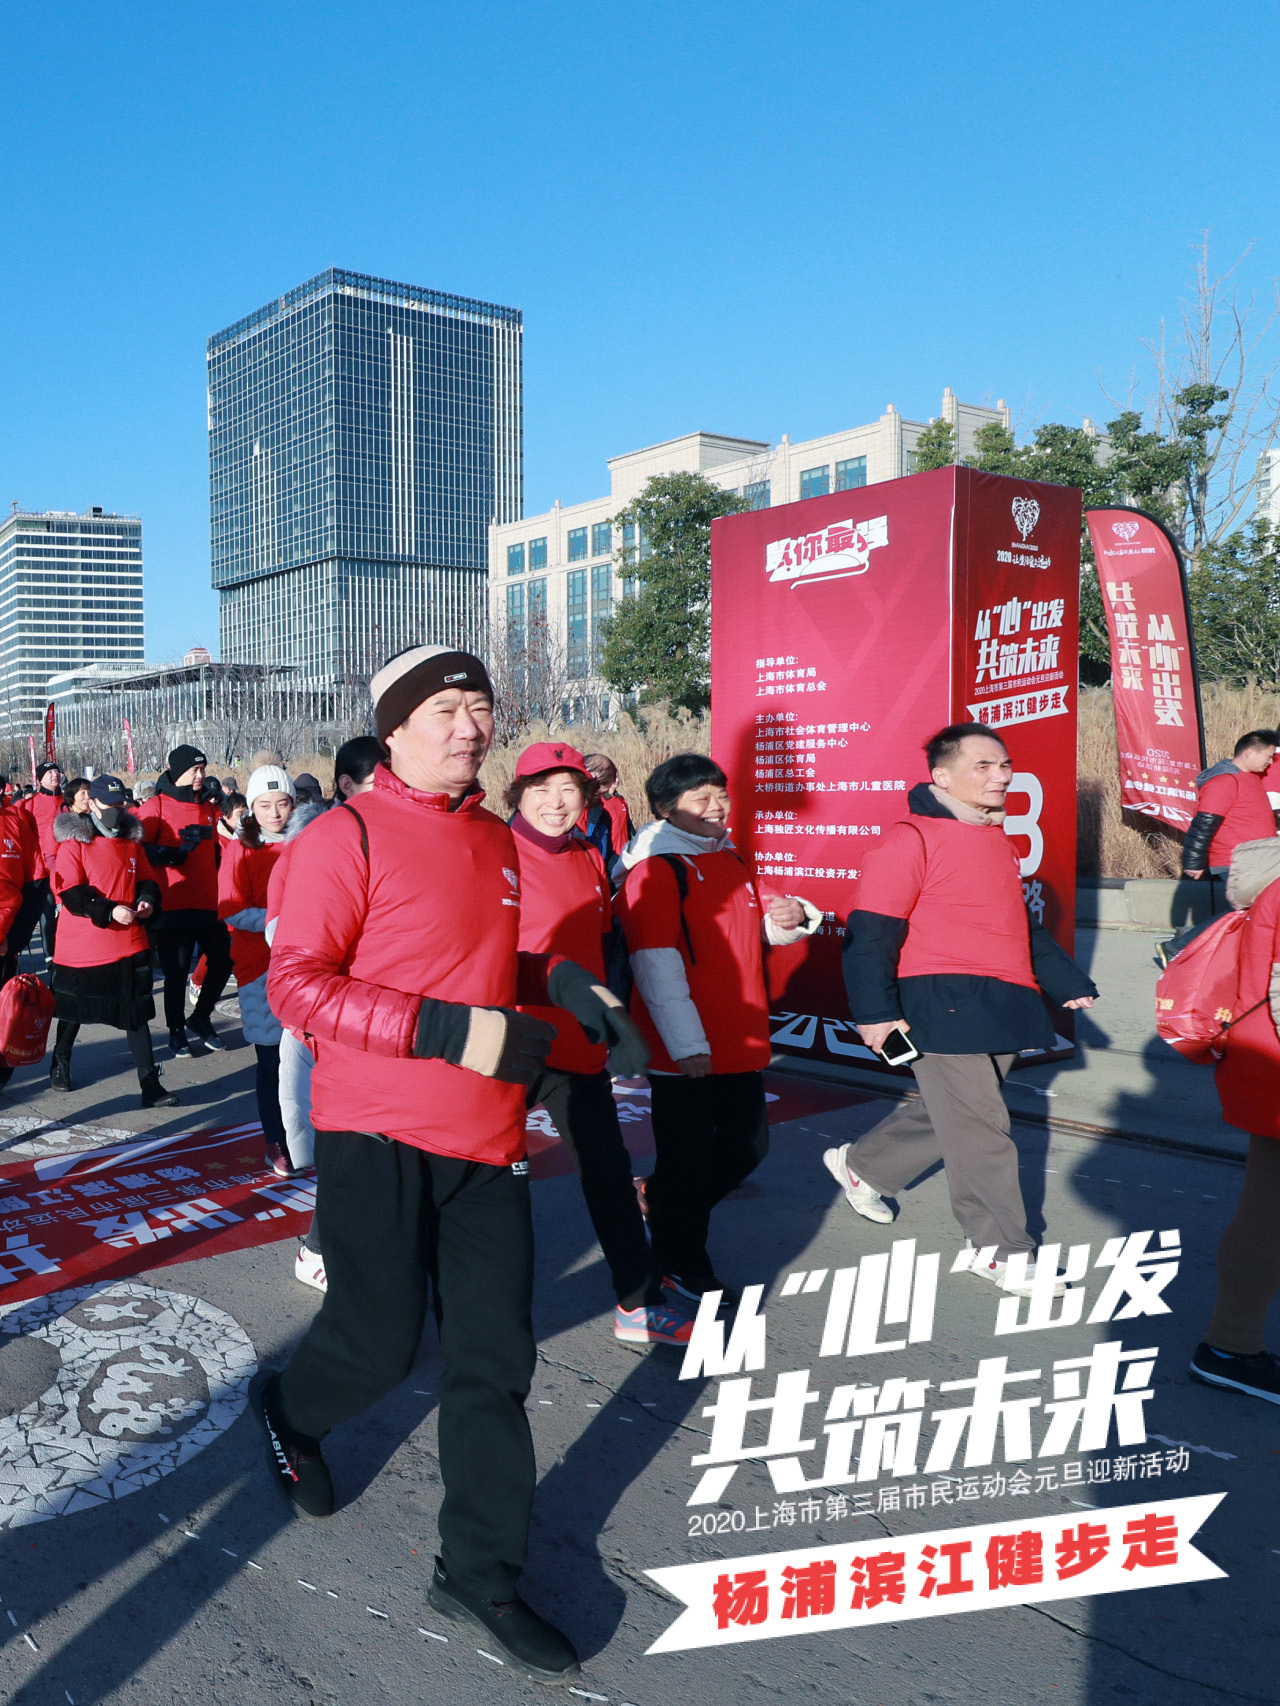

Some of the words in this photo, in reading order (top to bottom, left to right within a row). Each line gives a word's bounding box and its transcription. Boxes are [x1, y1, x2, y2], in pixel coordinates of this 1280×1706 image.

[975, 634, 1060, 684] 共筑未来
[755, 667, 817, 683] 上海市体育局
[755, 681, 827, 697] 上海市体育总会
[979, 691, 1061, 725] 杨浦滨江健步走
[755, 721, 872, 738] 上海市社会体育管理中心
[755, 738, 849, 752] 杨浦区党建服务中心
[755, 753, 816, 766] 杨浦区体育局
[755, 767, 816, 779] 杨浦区总工会
[755, 865, 862, 880] 上海杨浦滨江投资开发
